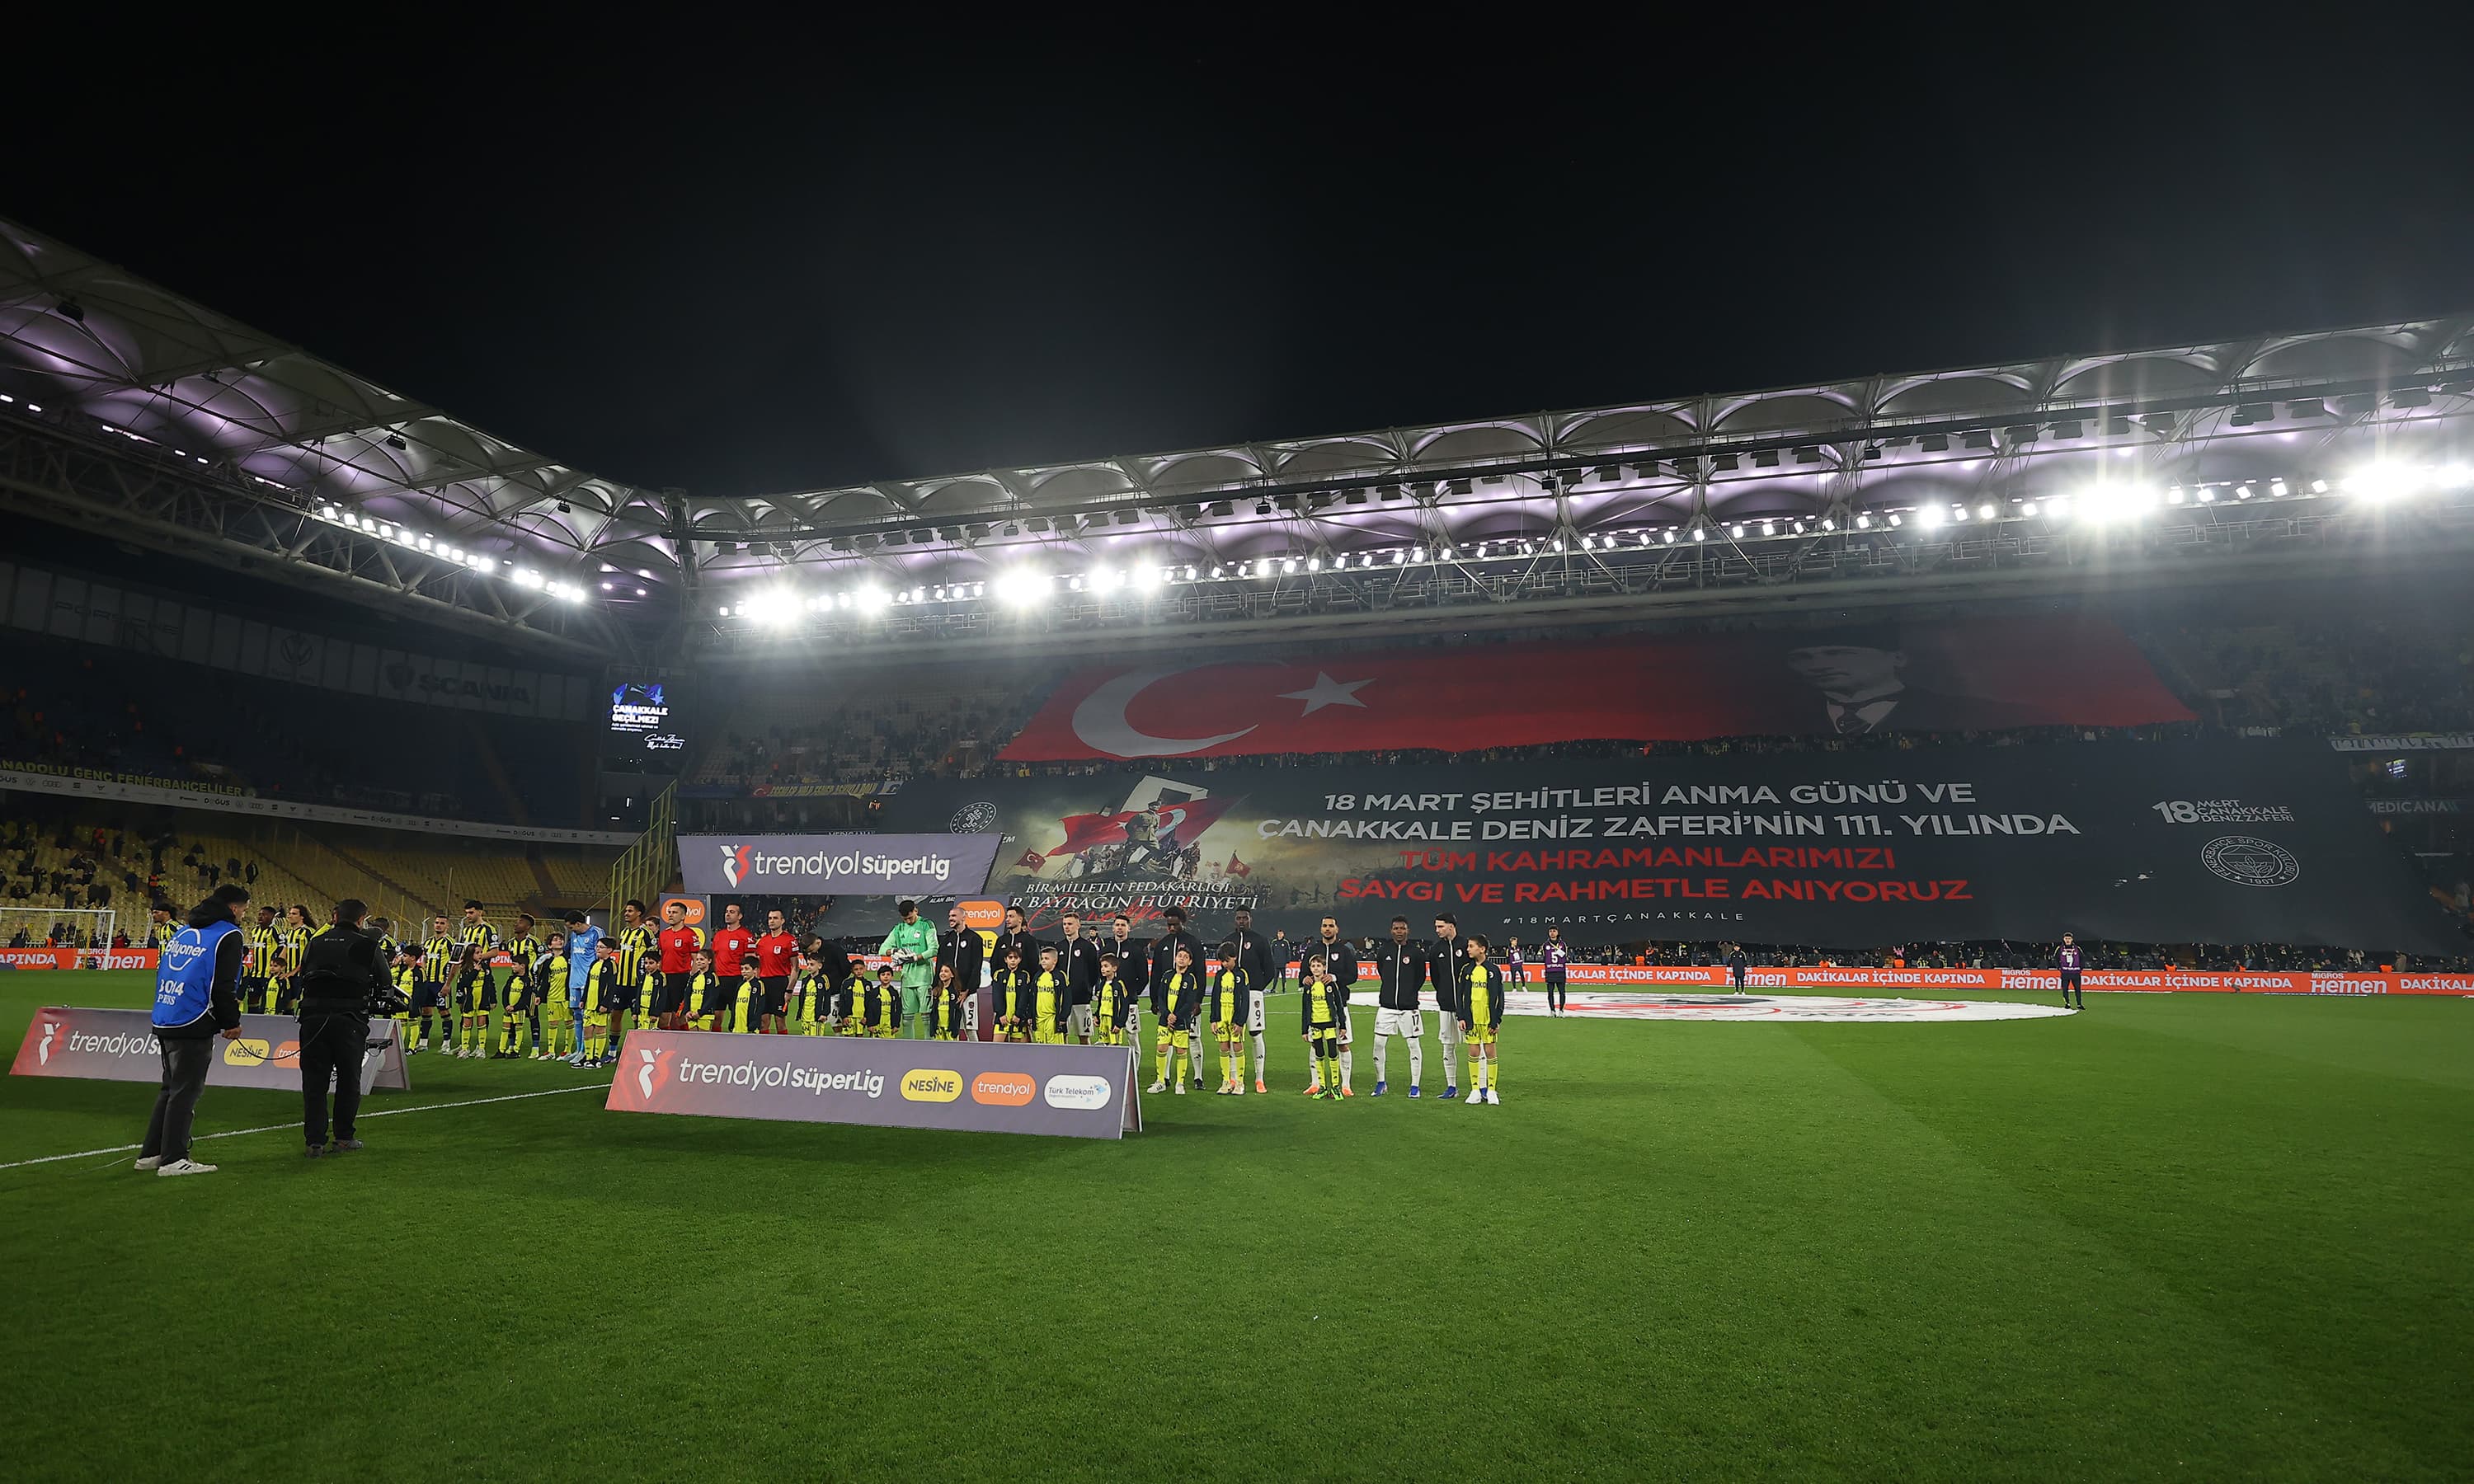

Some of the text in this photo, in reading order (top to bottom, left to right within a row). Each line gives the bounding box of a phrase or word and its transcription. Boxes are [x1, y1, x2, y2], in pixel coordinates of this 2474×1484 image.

[417, 673, 531, 704] SCANIA
[612, 704, 669, 716] ÇANAKKALE
[1324, 780, 1977, 815] 18 MART ŞEHİTLERİ ANMA GÜNÜ VE
[2152, 801, 2200, 824] 18
[1256, 819, 1473, 841] ÇANAKKALE
[1481, 814, 1593, 840] DENİZ
[1899, 814, 2081, 836] YILINDA
[754, 851, 859, 880] trendyol
[1399, 847, 1896, 872] TÜM KAHRAMANLARIMIZI
[1025, 881, 1042, 893] BİR
[1045, 881, 1124, 893] MİLLETİN
[2249, 877, 2275, 885] 1907
[1338, 878, 1973, 903] SAYGI VE RAHMETLE ANIYORUZ
[1028, 893, 1132, 909] BAYRAĞIN
[1139, 893, 1259, 910] HÜRRİYETİ
[165, 938, 207, 957] Bilyoner
[0, 953, 57, 965] APINDA
[1608, 968, 1653, 982] İÇİNDE
[1656, 970, 1711, 981] KAPINDA
[1796, 970, 1985, 985] DAKİKALAR İÇİNDE KAPINDA
[2081, 974, 2293, 989] DAKİKALAR İÇİNDE KAPINDA
[2309, 979, 2387, 993] Hemen
[968, 1010, 974, 1020] 5
[1083, 1017, 1092, 1027] 10
[1131, 1014, 1136, 1025] 2
[1255, 1010, 1261, 1020] 9
[1411, 1014, 1420, 1026] 17
[69, 1030, 149, 1058] trendyol
[679, 1058, 791, 1092] trendyol
[977, 1081, 1031, 1097] trendyol
[1048, 1086, 1063, 1095] Türk
[1065, 1087, 1094, 1097] Telekom
